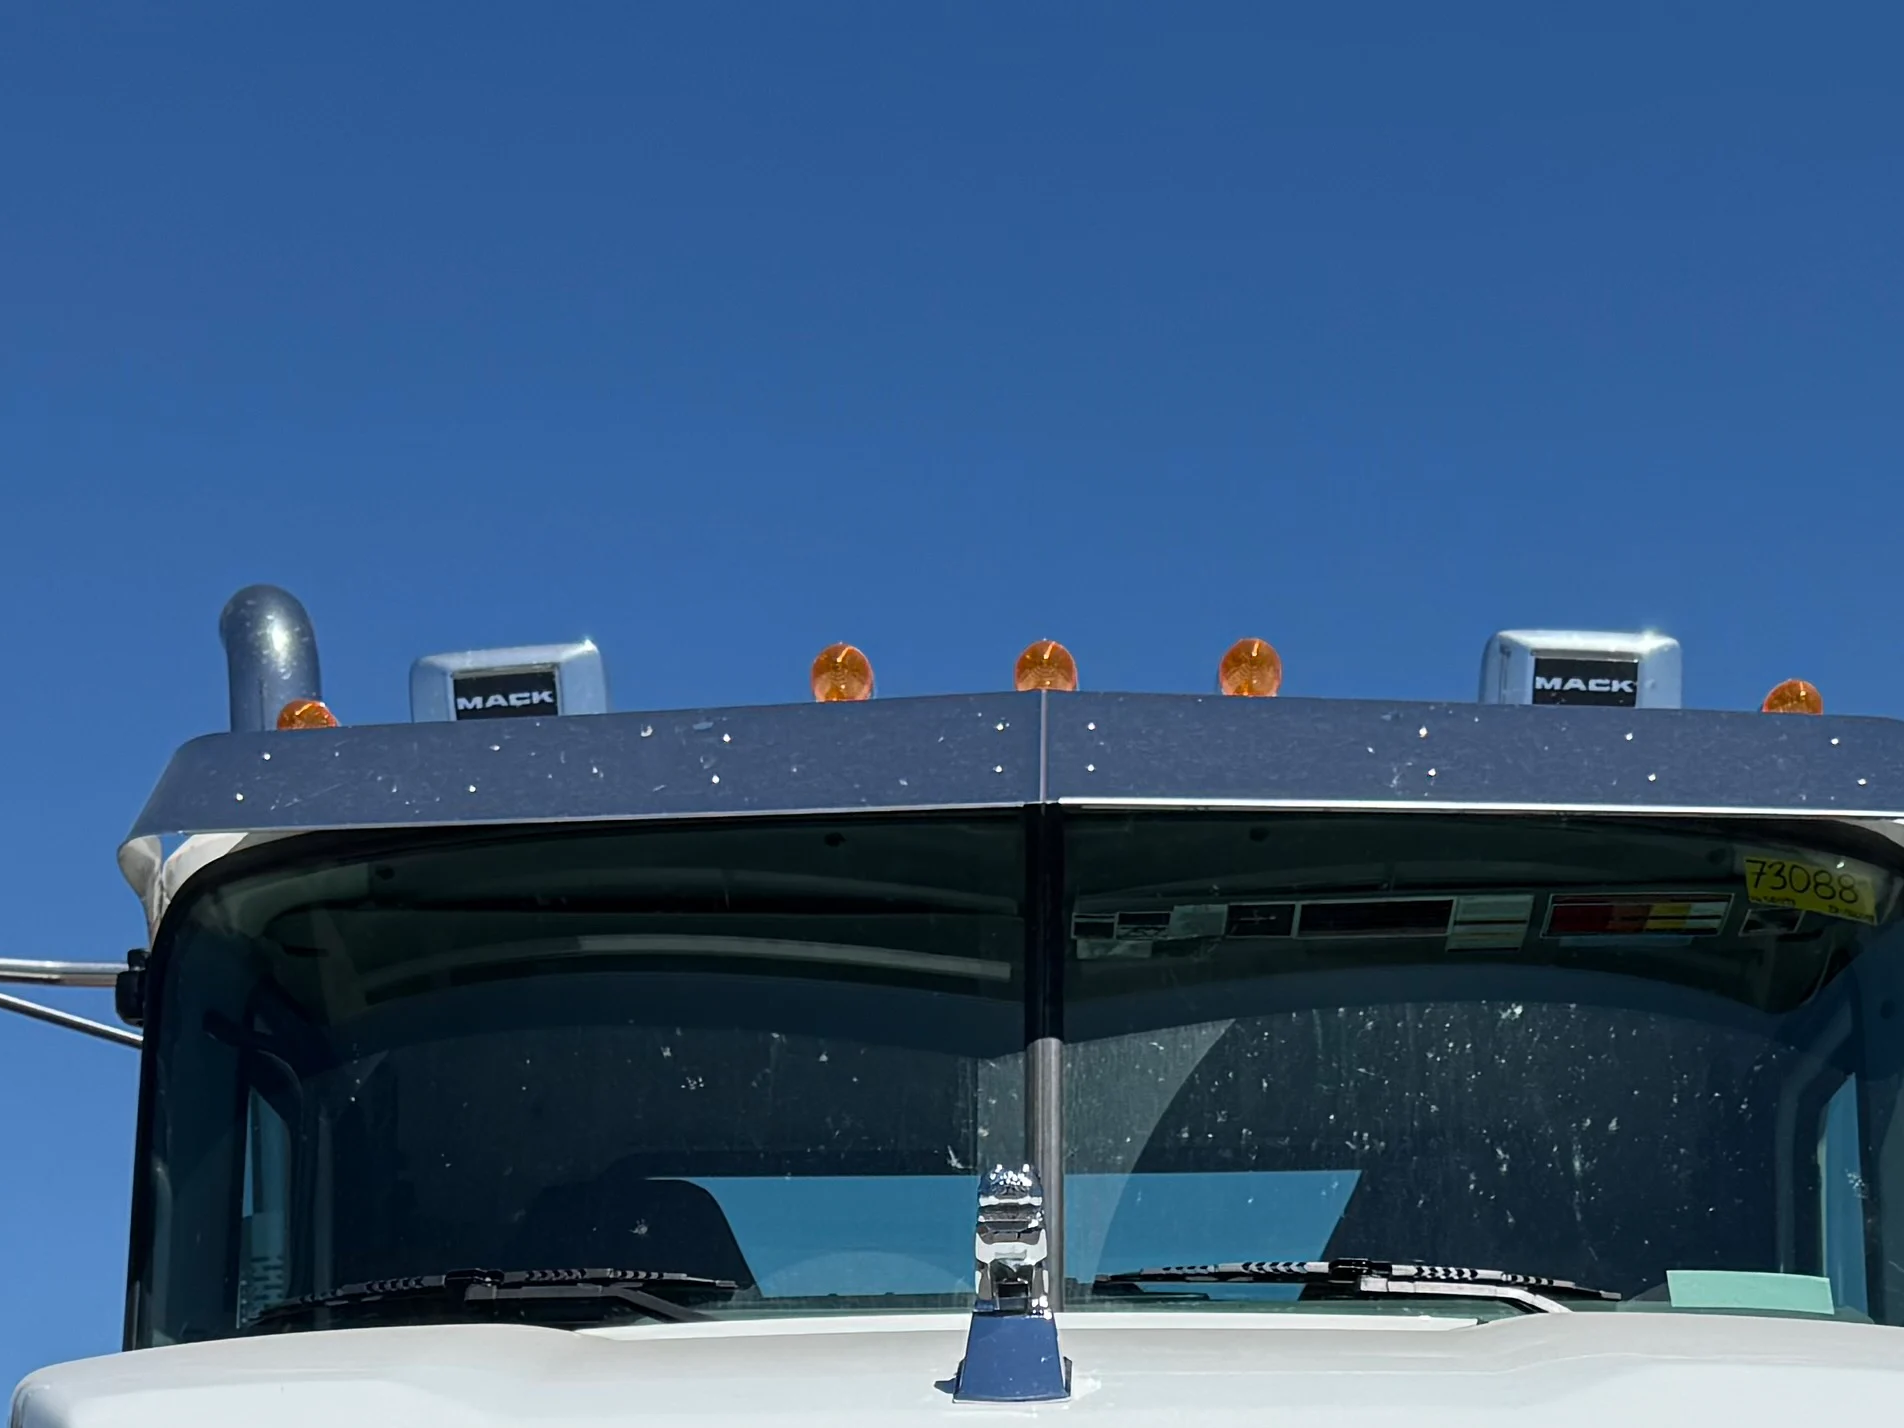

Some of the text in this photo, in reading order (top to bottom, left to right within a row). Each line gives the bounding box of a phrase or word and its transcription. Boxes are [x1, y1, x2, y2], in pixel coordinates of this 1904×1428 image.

[1535, 676, 1634, 693] MACK
[456, 690, 554, 711] MACK
[1745, 858, 1859, 904] 73088
